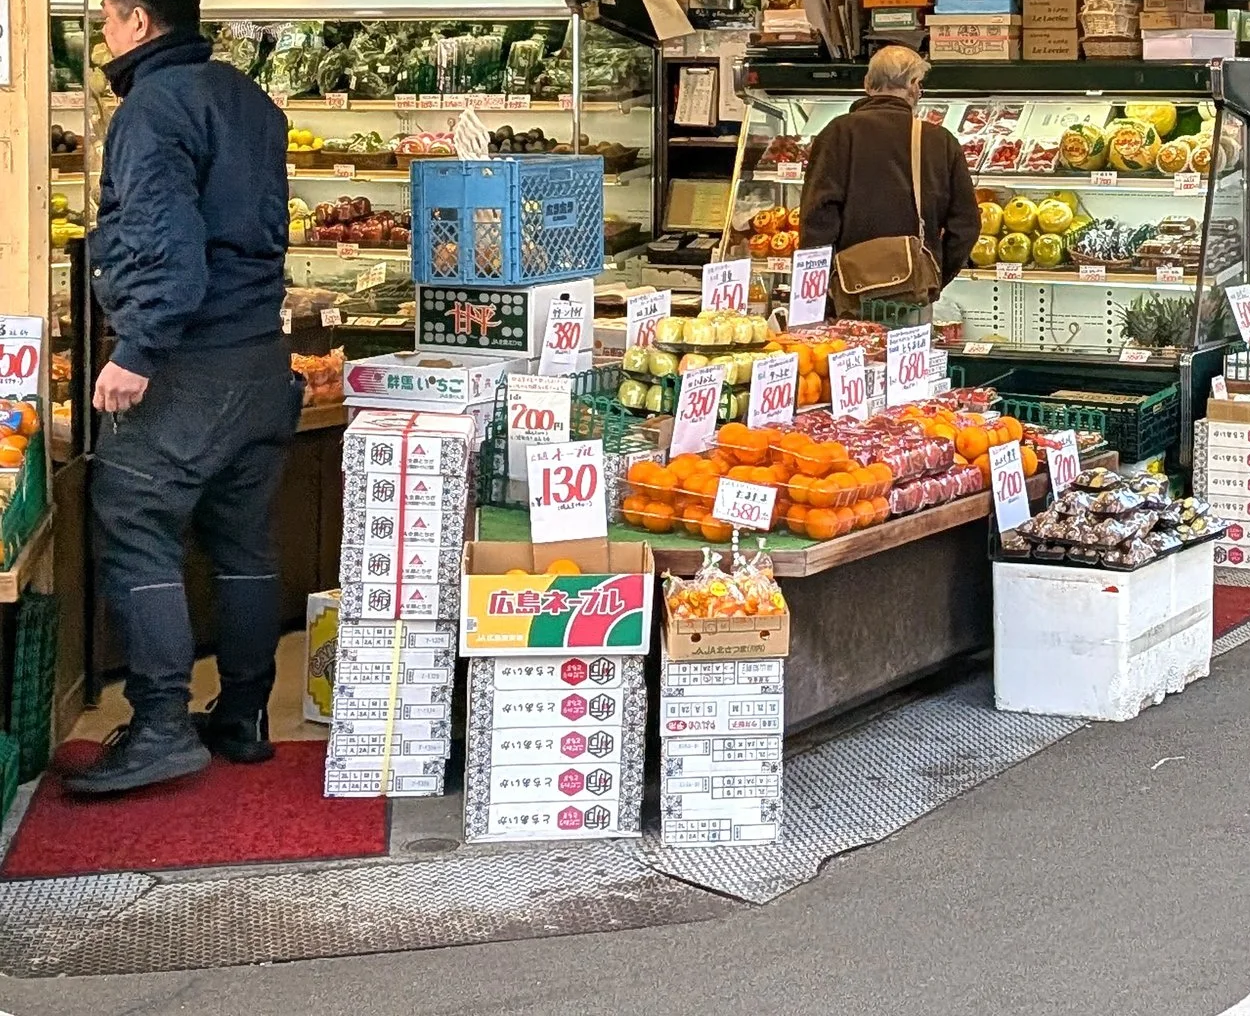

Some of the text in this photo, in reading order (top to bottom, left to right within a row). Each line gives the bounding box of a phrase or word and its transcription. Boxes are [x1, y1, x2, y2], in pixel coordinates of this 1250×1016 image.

[551, 321, 581, 351] 380
[387, 373, 464, 393] 群馬いちご
[487, 589, 626, 616] 広島ネーブル
